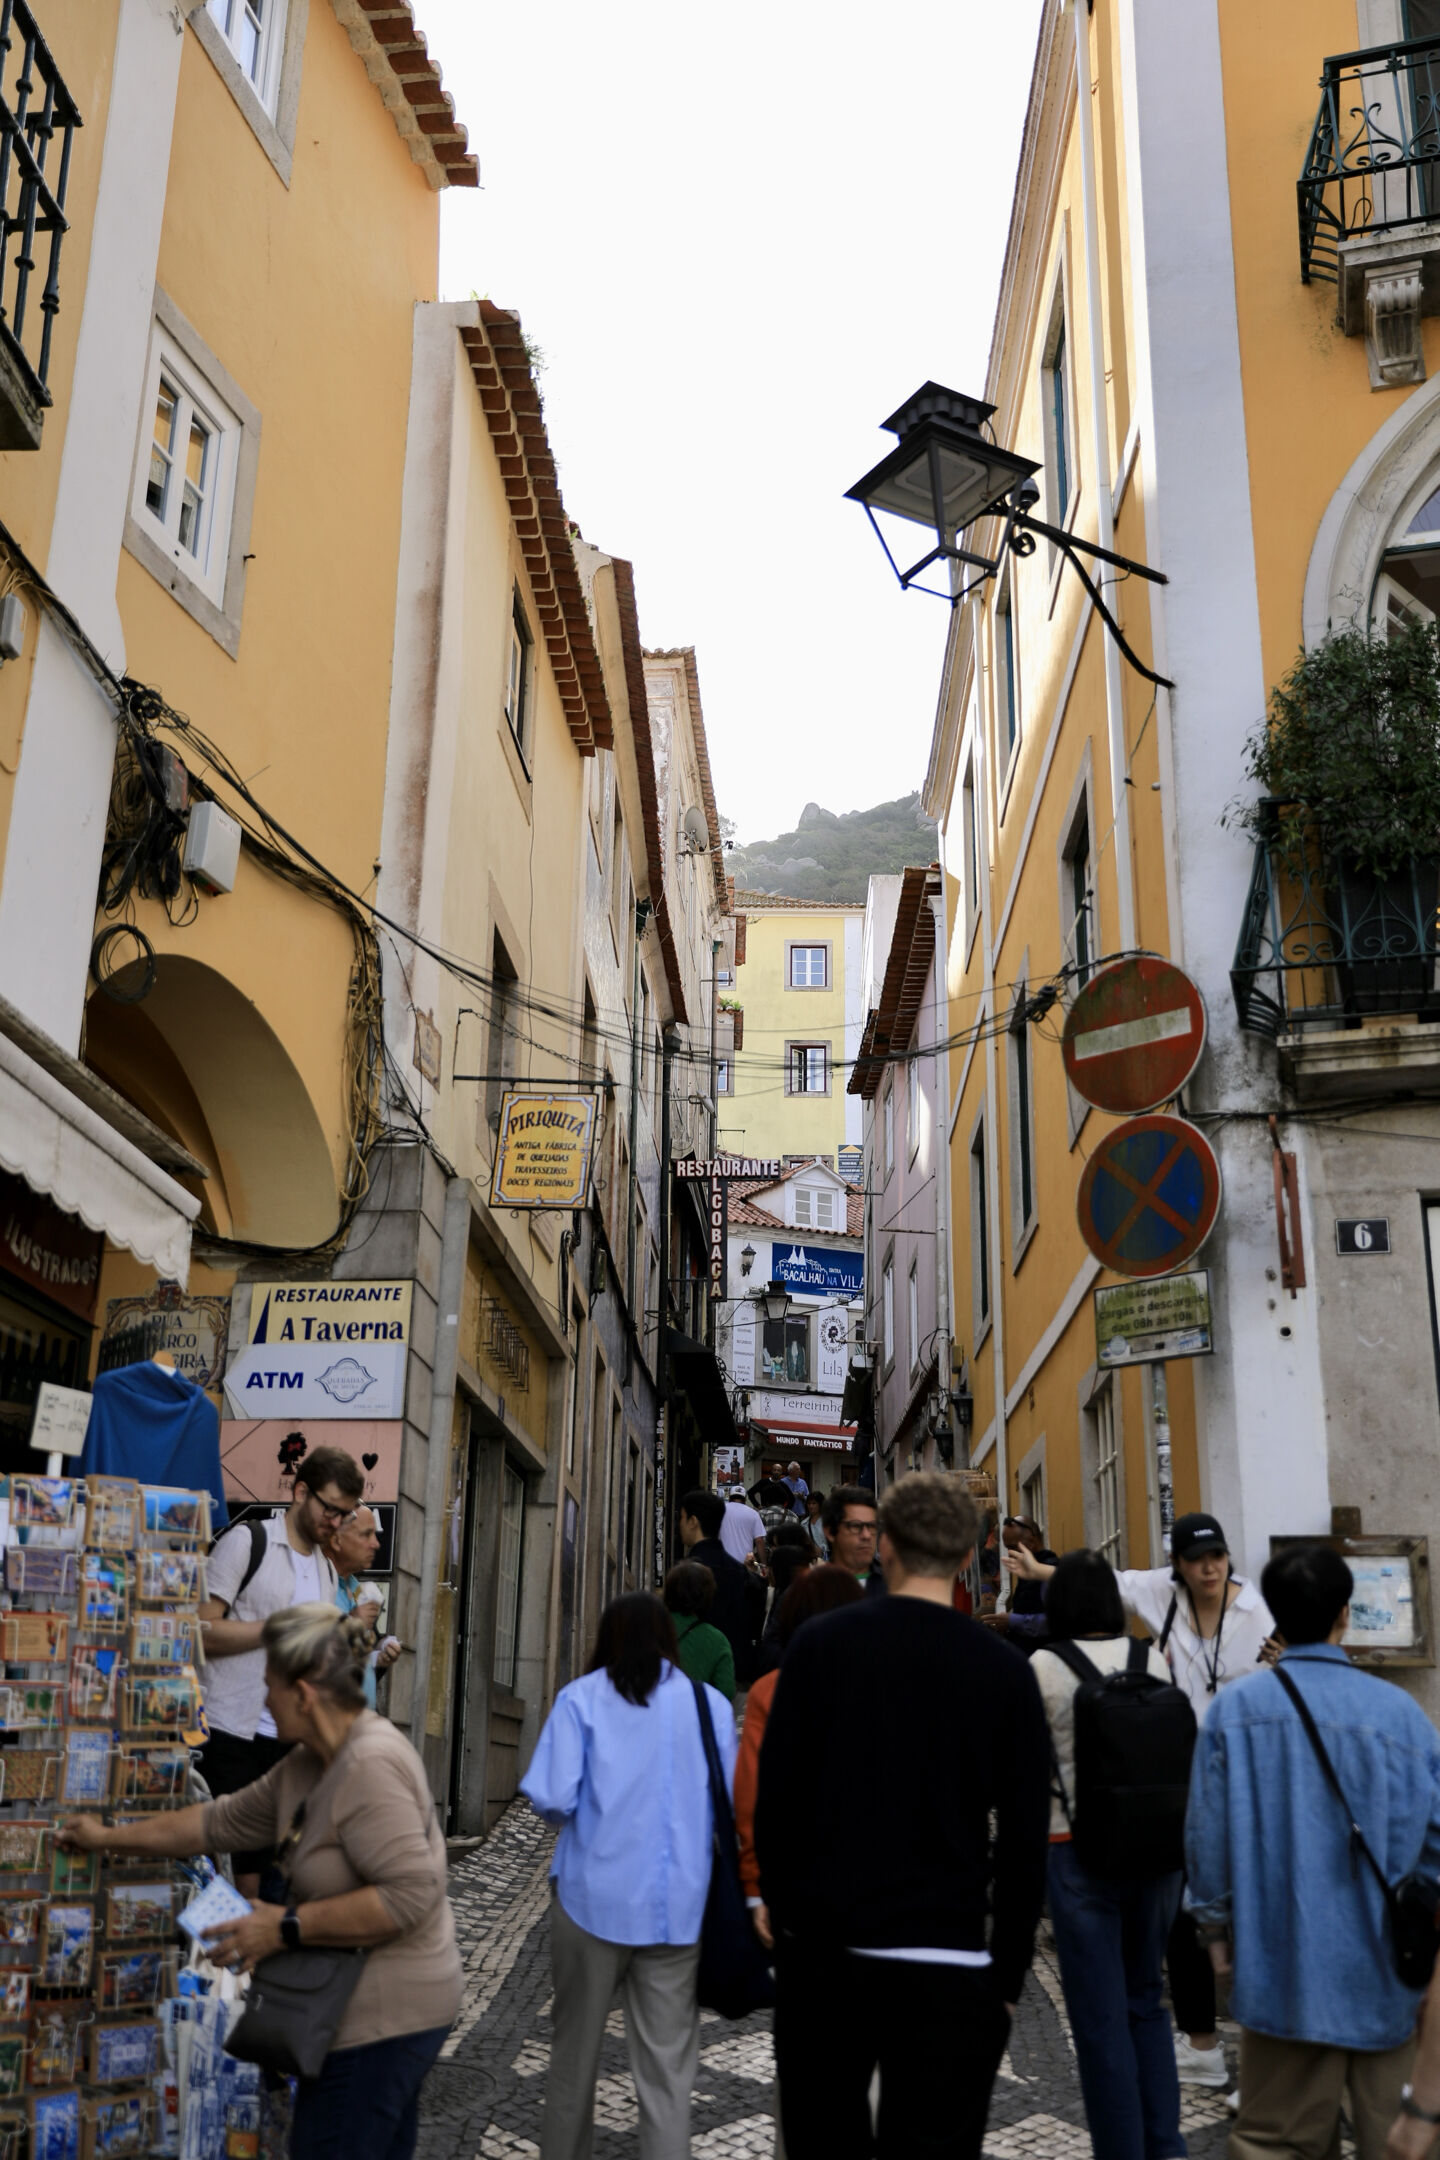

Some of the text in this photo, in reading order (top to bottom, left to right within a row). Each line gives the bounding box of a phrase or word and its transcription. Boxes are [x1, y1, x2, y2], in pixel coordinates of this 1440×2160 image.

[509, 1110, 585, 1137] PIRIQUITA
[514, 1141, 577, 1150] ANTIGA FÁBRICA
[517, 1153, 570, 1162] DE QUEIJADAS
[514, 1165, 568, 1175] TRAVESSEIROS
[676, 1159, 780, 1177] RESTAURANTE
[506, 1178, 575, 1188] DOCES REGIONAIS
[1353, 1222, 1373, 1250] 6
[783, 1269, 865, 1289] BACALHAU NA VILA
[274, 1287, 403, 1303] RESTAURANTE
[1137, 1304, 1145, 1313] e
[280, 1317, 404, 1341] A Taverna
[823, 1360, 843, 1378] Lila
[246, 1371, 304, 1389] ATM
[776, 1436, 800, 1446] MUNDO
